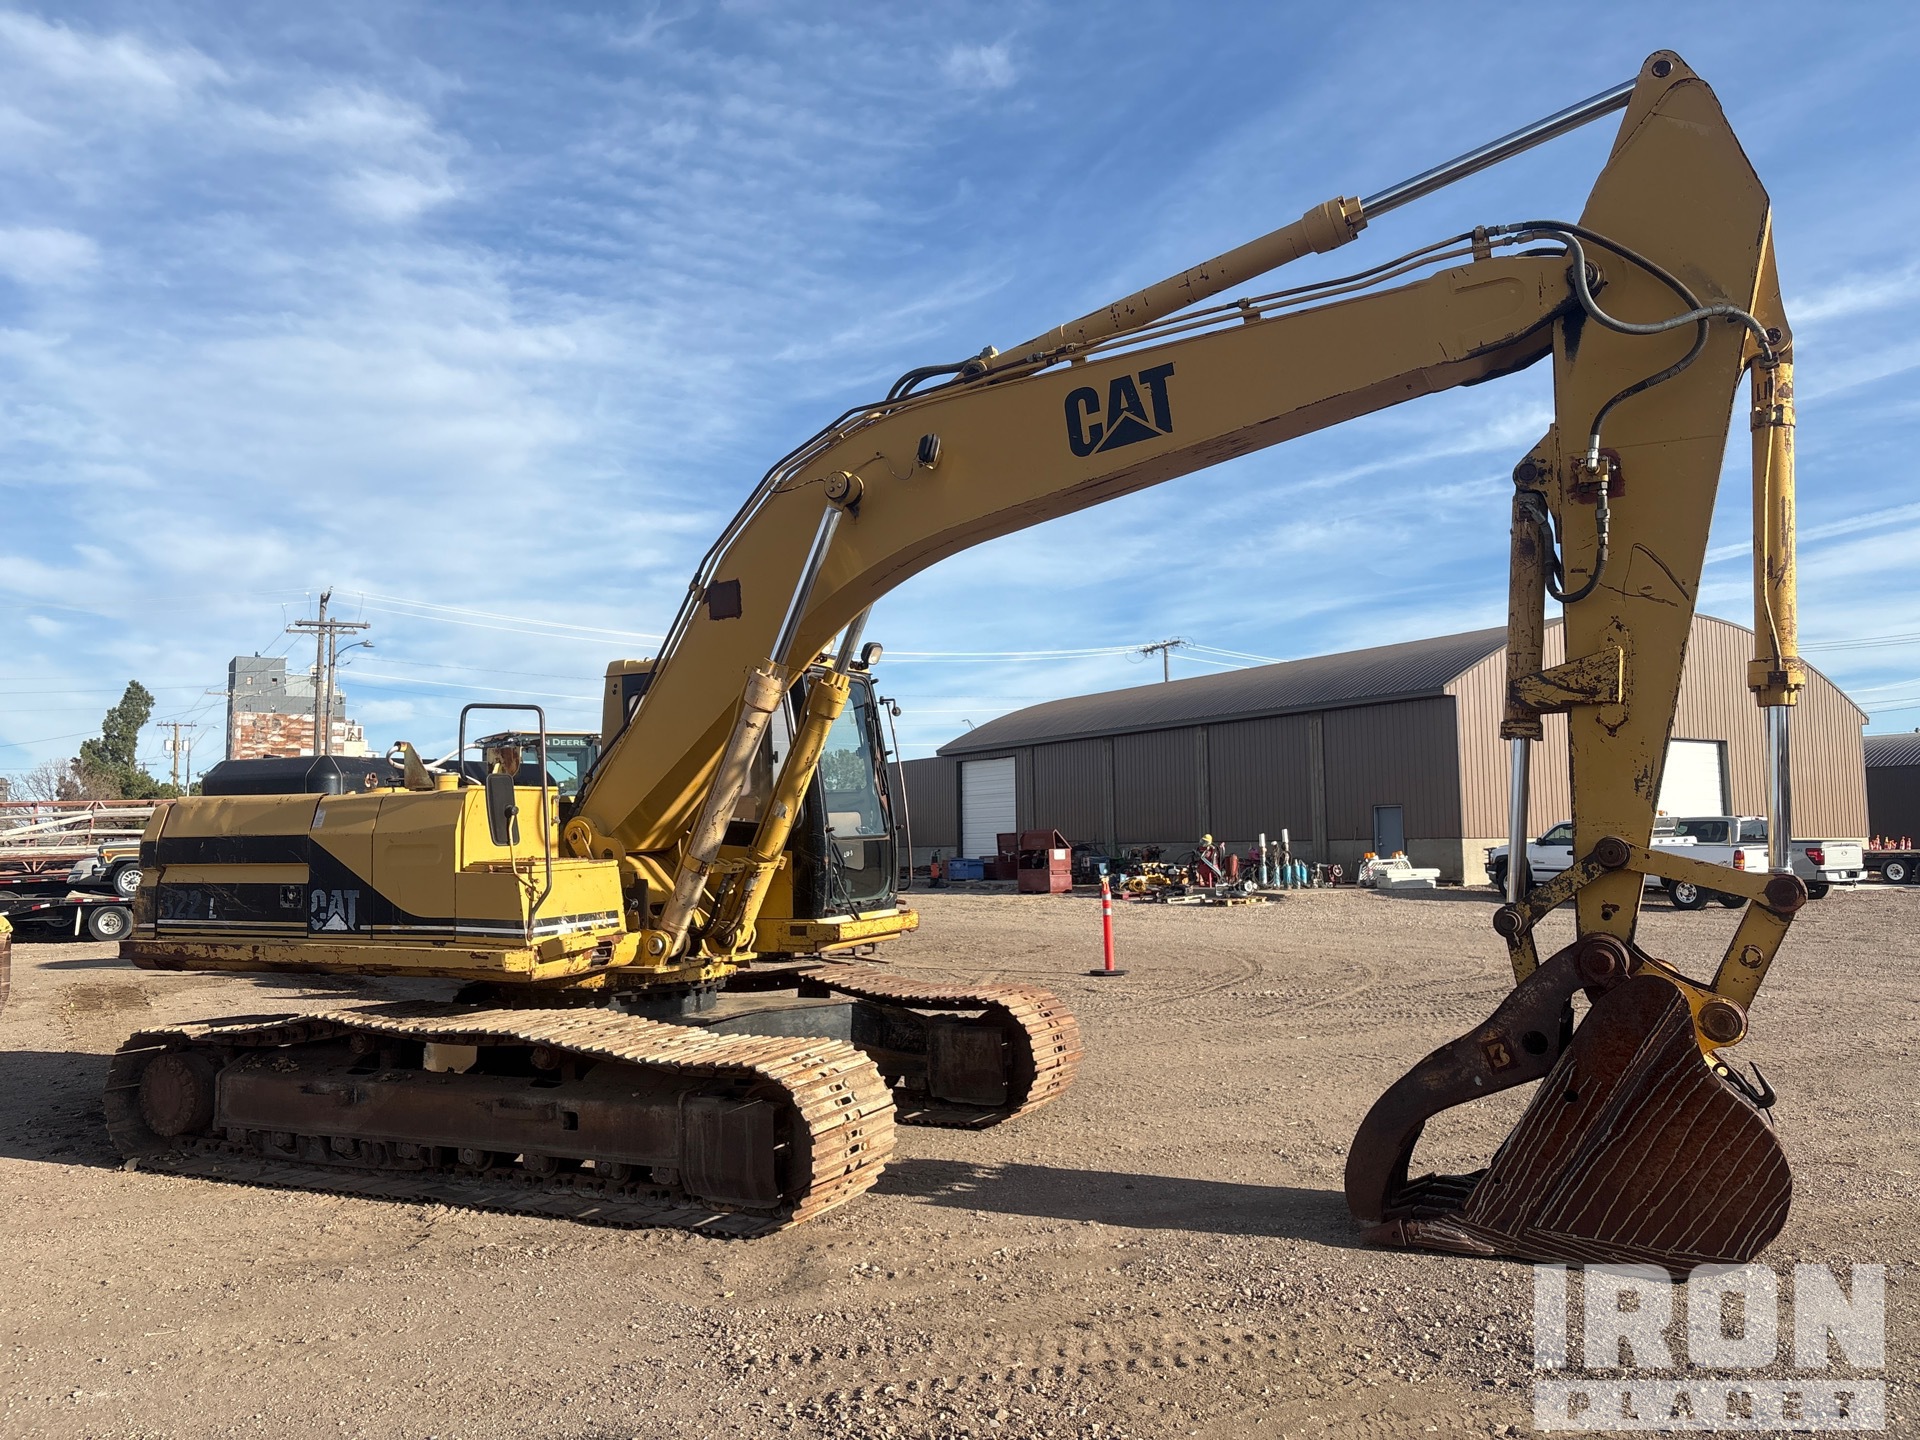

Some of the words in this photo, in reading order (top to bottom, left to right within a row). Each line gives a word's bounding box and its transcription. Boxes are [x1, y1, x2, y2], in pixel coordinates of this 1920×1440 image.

[1064, 362, 1175, 457] CAT
[552, 738, 587, 746] DEERE
[311, 889, 360, 931] CAT
